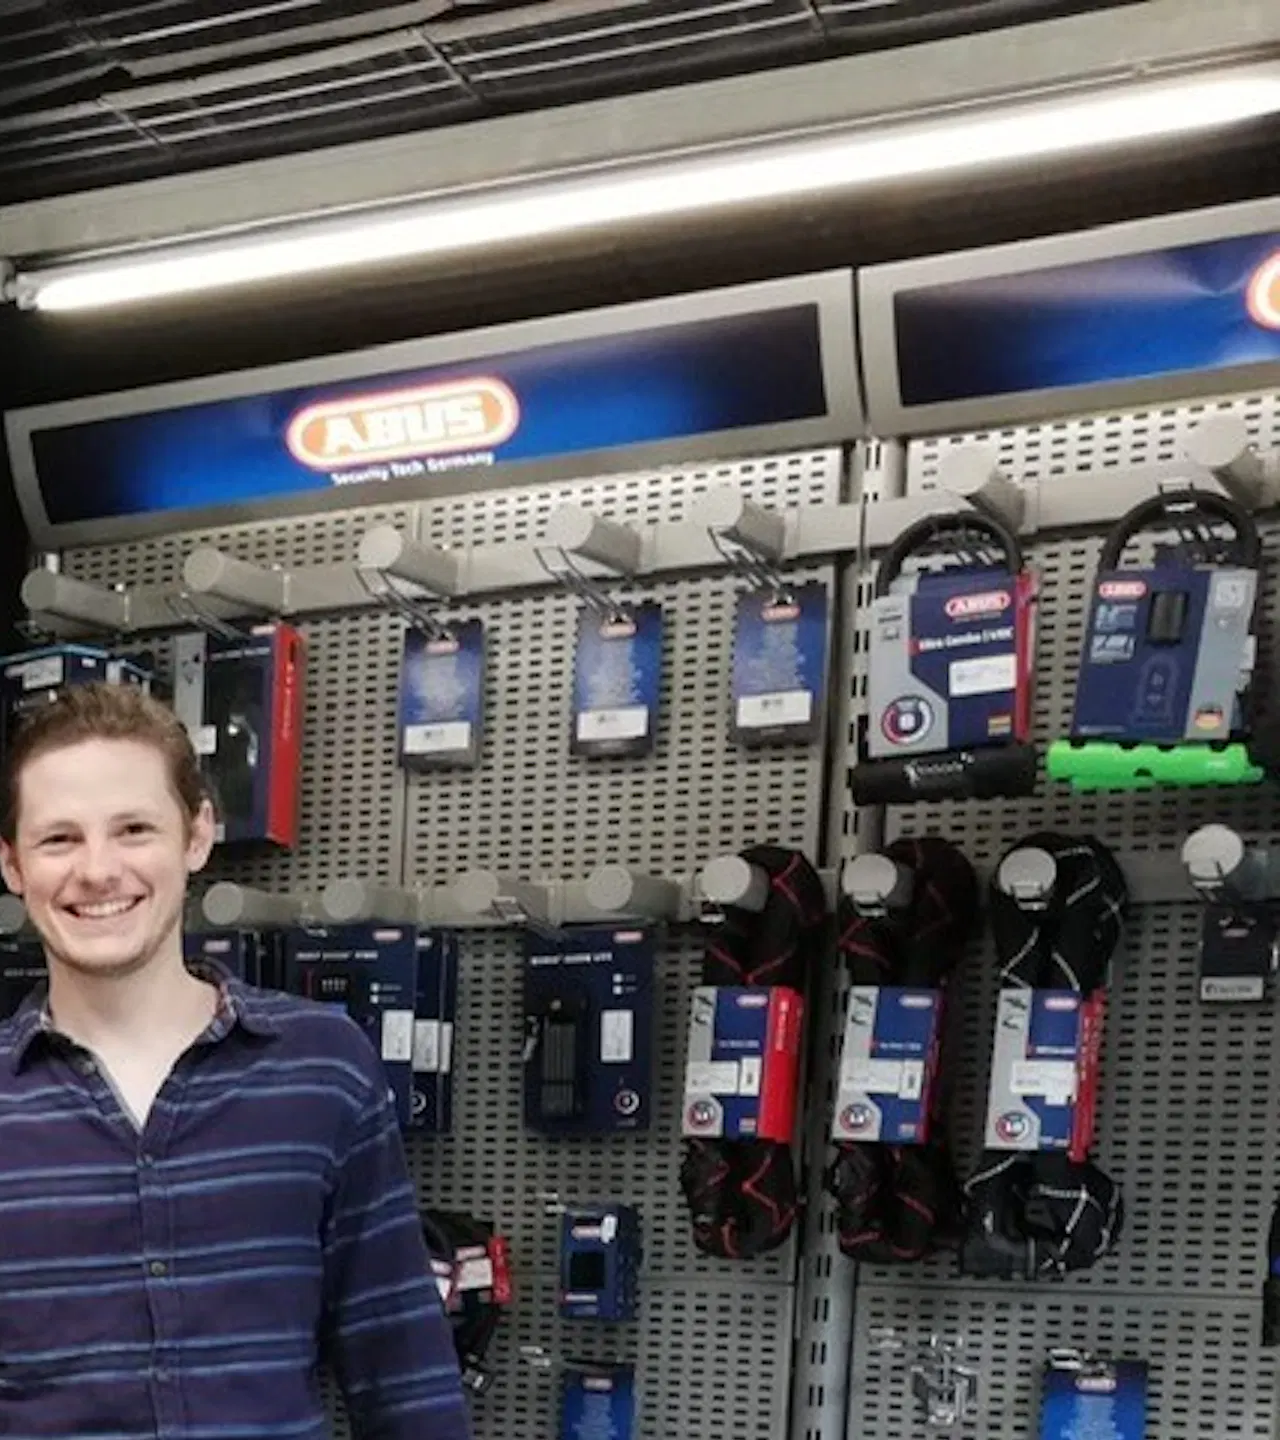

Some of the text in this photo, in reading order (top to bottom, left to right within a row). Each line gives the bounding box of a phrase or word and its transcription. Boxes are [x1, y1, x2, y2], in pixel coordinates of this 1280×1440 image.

[330, 450, 496, 488] Security Tech Germany
